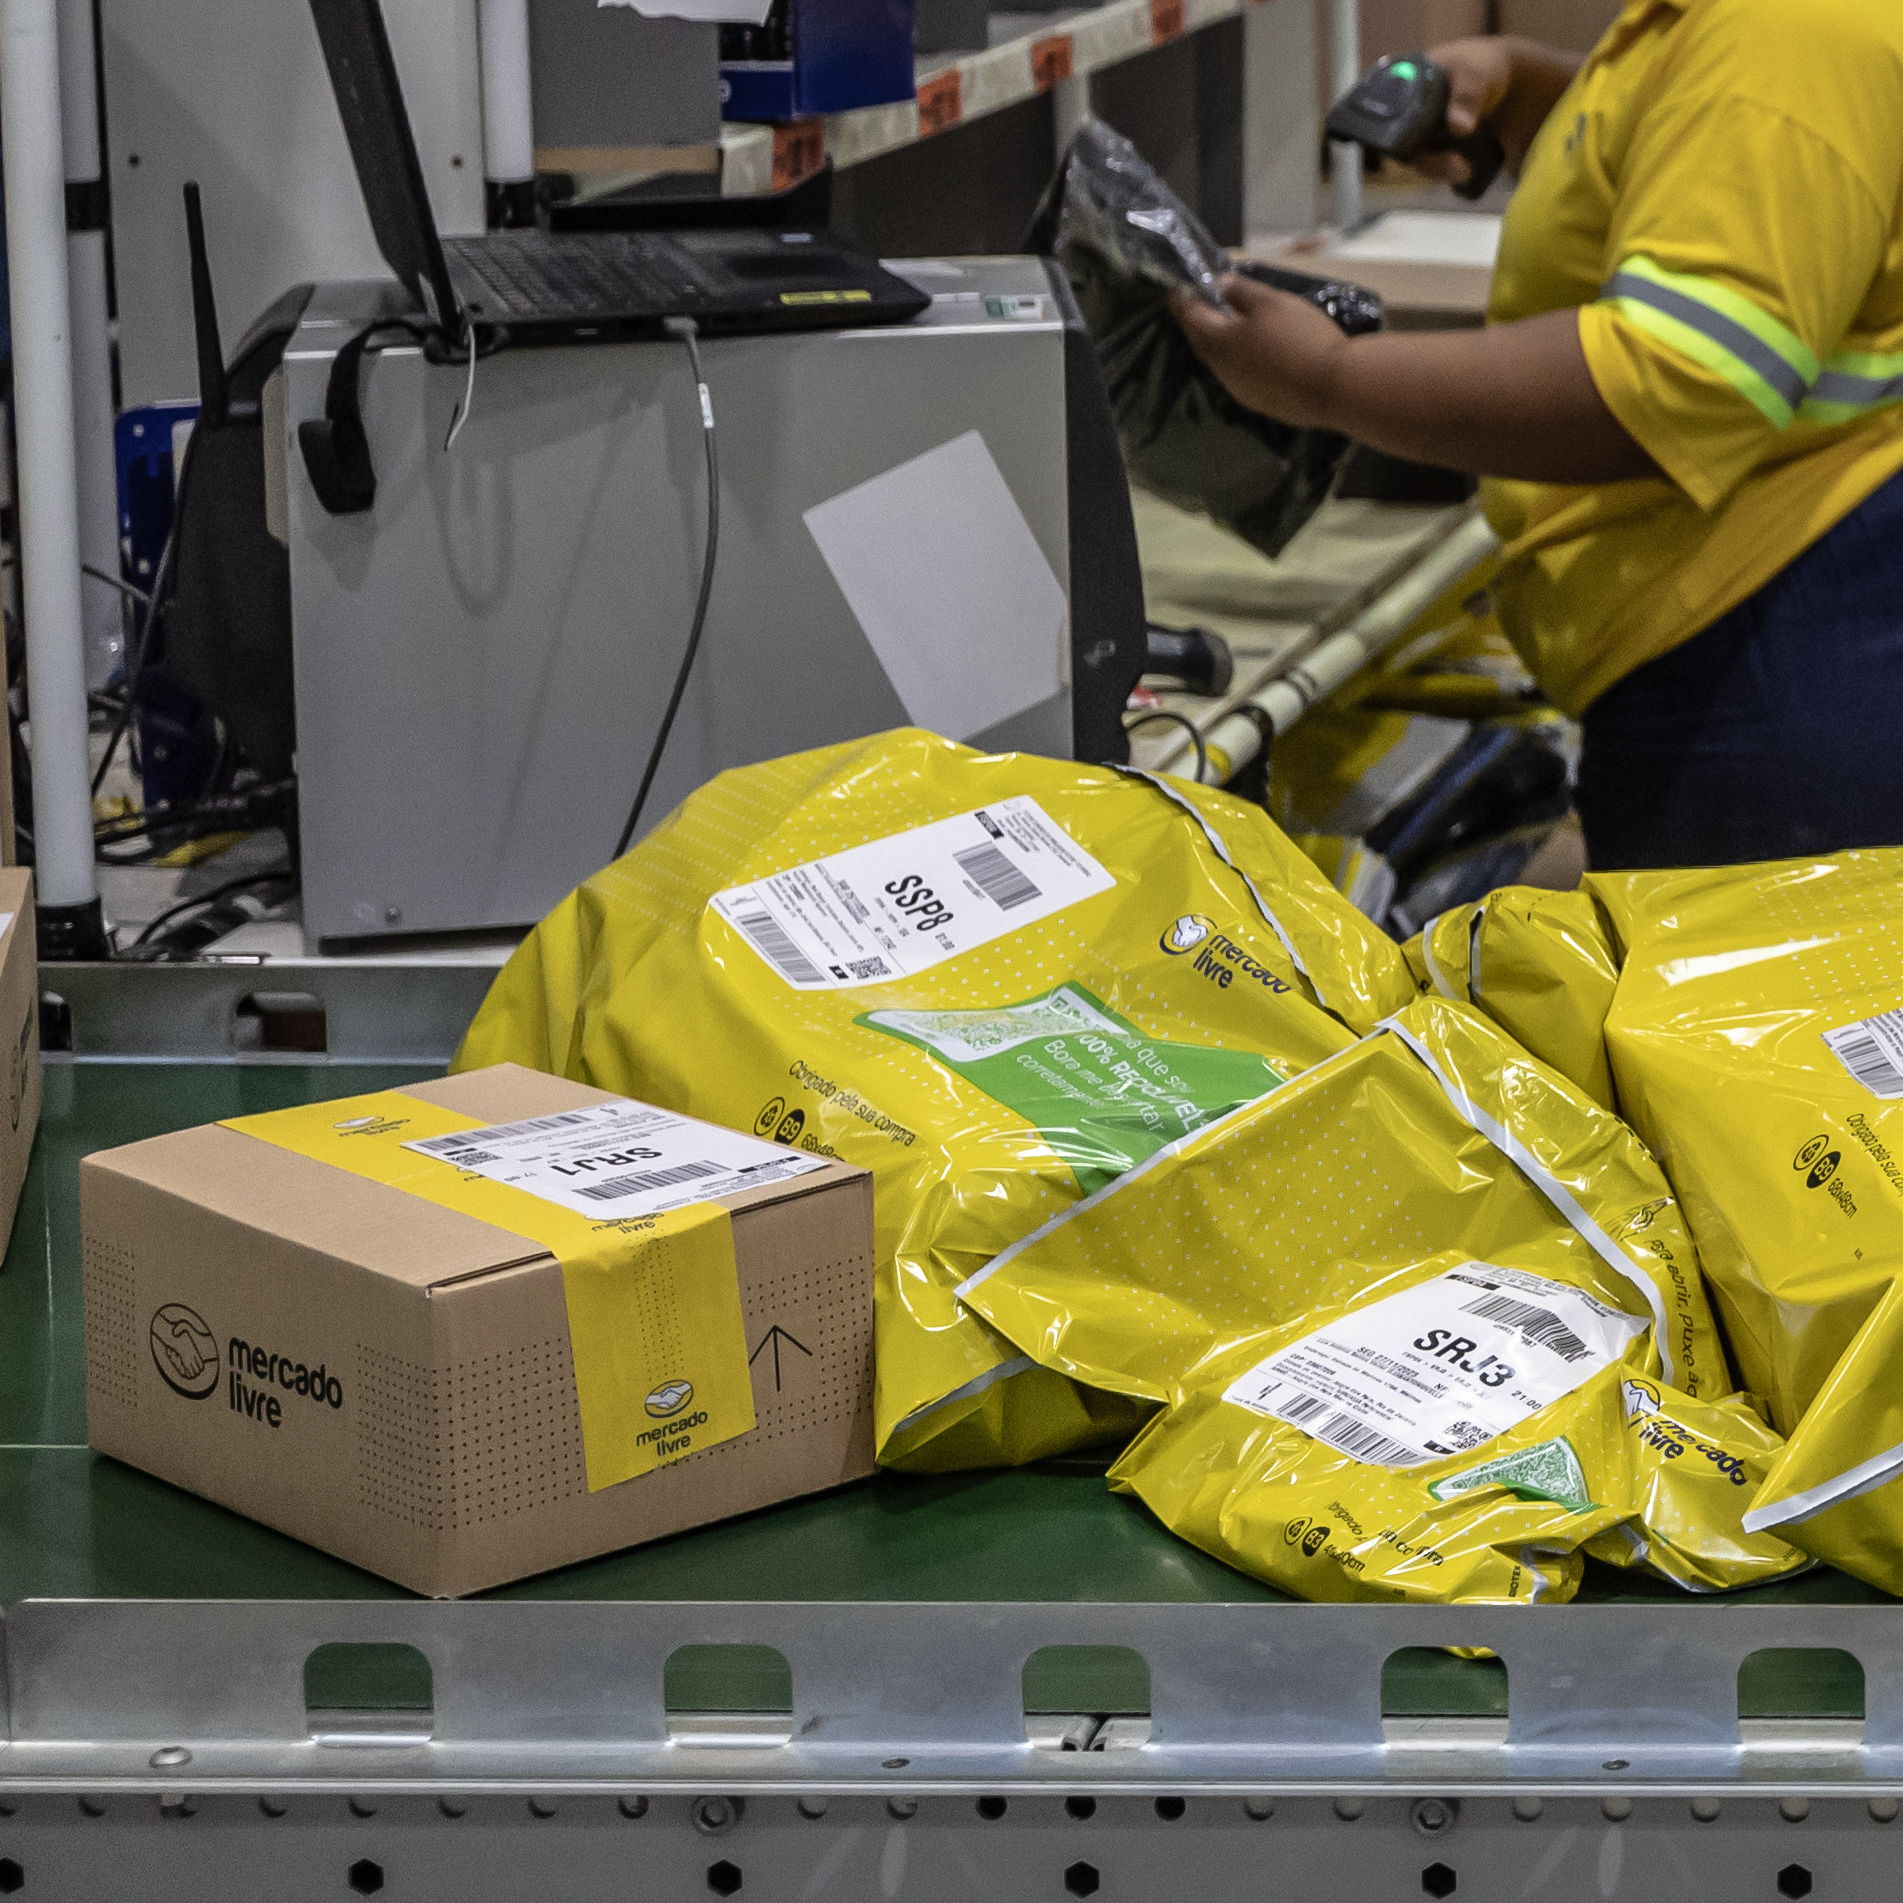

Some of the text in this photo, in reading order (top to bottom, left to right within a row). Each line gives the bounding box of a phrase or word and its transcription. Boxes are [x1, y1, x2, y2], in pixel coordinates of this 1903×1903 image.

[884, 875, 954, 931] SSP8
[1193, 947, 1233, 988] livre
[1075, 1034, 1118, 1064] 00%
[790, 1060, 916, 1147] Obrigado pela sua compra
[550, 1147, 663, 1176] SRJ1
[1846, 1113, 1878, 1147] Obrigado
[1864, 1142, 1892, 1162] pela
[1880, 1159, 1901, 1178] sua
[229, 1337, 343, 1409] mercado
[1413, 1329, 1516, 1387] SRJ3
[1678, 1312, 1695, 1370] puxe
[1687, 1375, 1698, 1399] aq
[229, 1372, 282, 1428] livre
[1511, 1389, 1542, 1410] 21:00
[636, 1409, 708, 1447] mercado
[656, 1433, 690, 1456] livre
